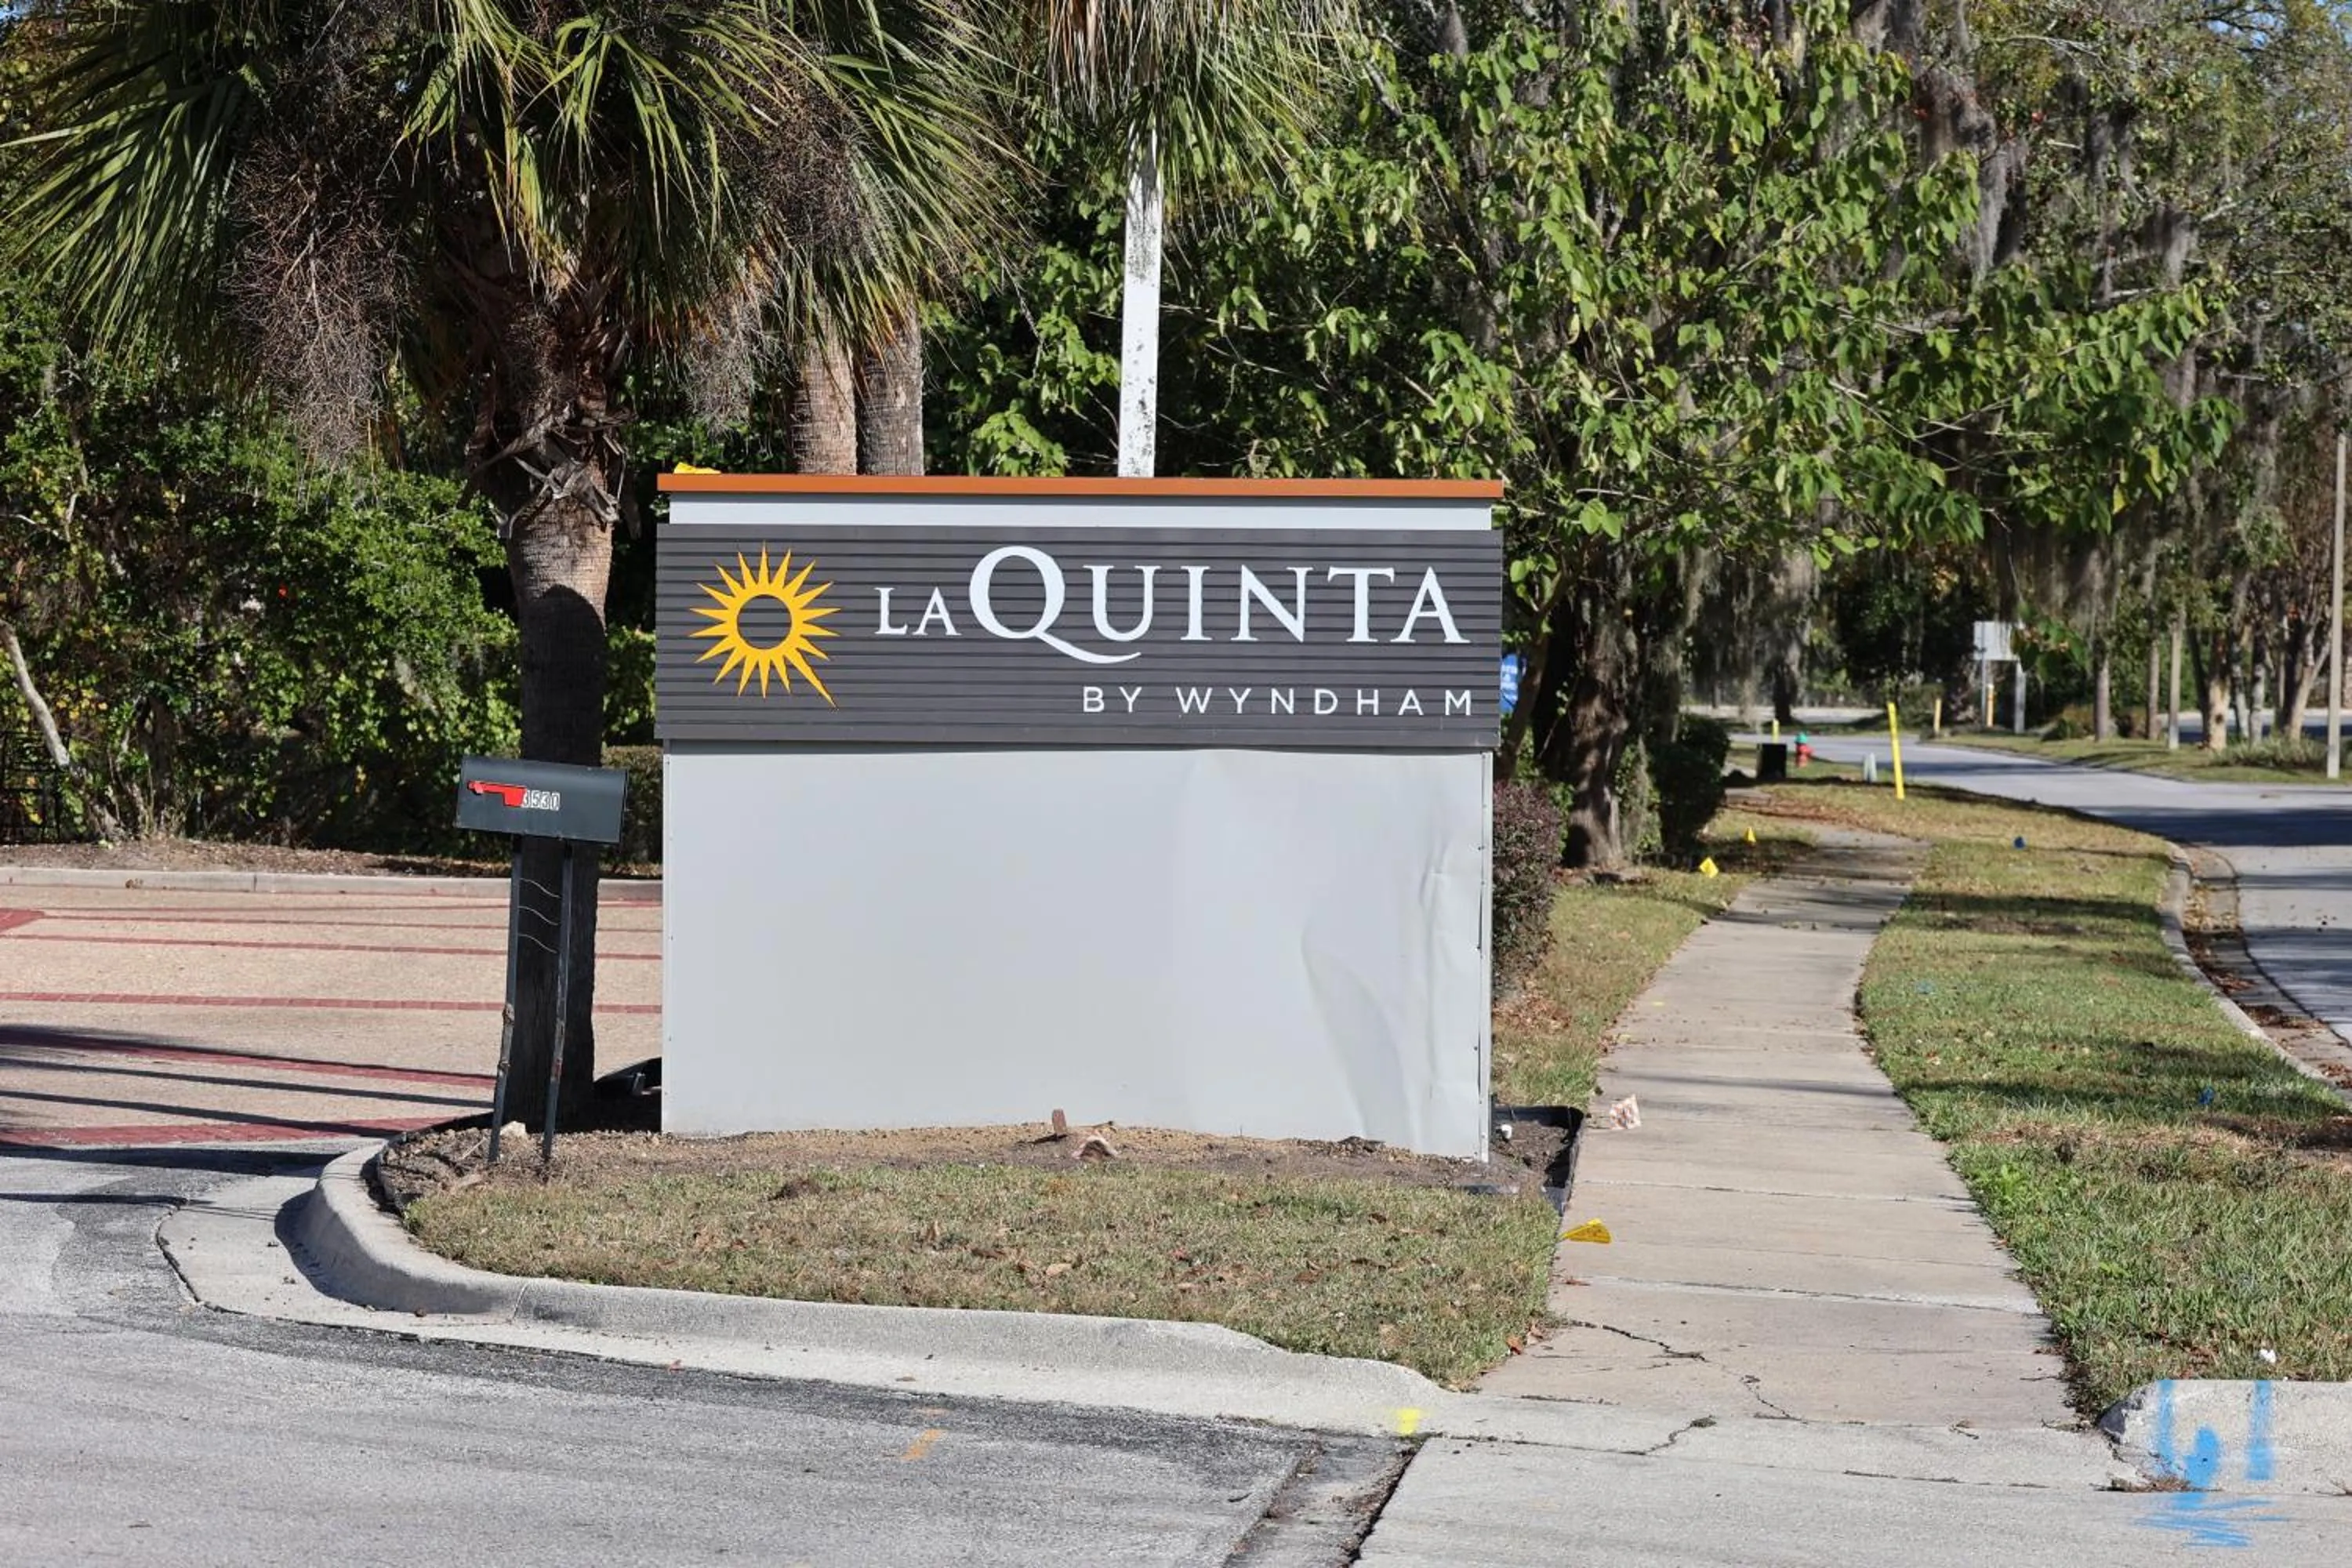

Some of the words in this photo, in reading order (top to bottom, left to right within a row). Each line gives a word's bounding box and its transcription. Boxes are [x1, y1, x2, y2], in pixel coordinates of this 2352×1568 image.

[874, 586, 962, 636] LA
[968, 546, 1472, 664] QUINTA
[1082, 686, 1143, 713] BY
[1174, 686, 1472, 717] WYNDHAM
